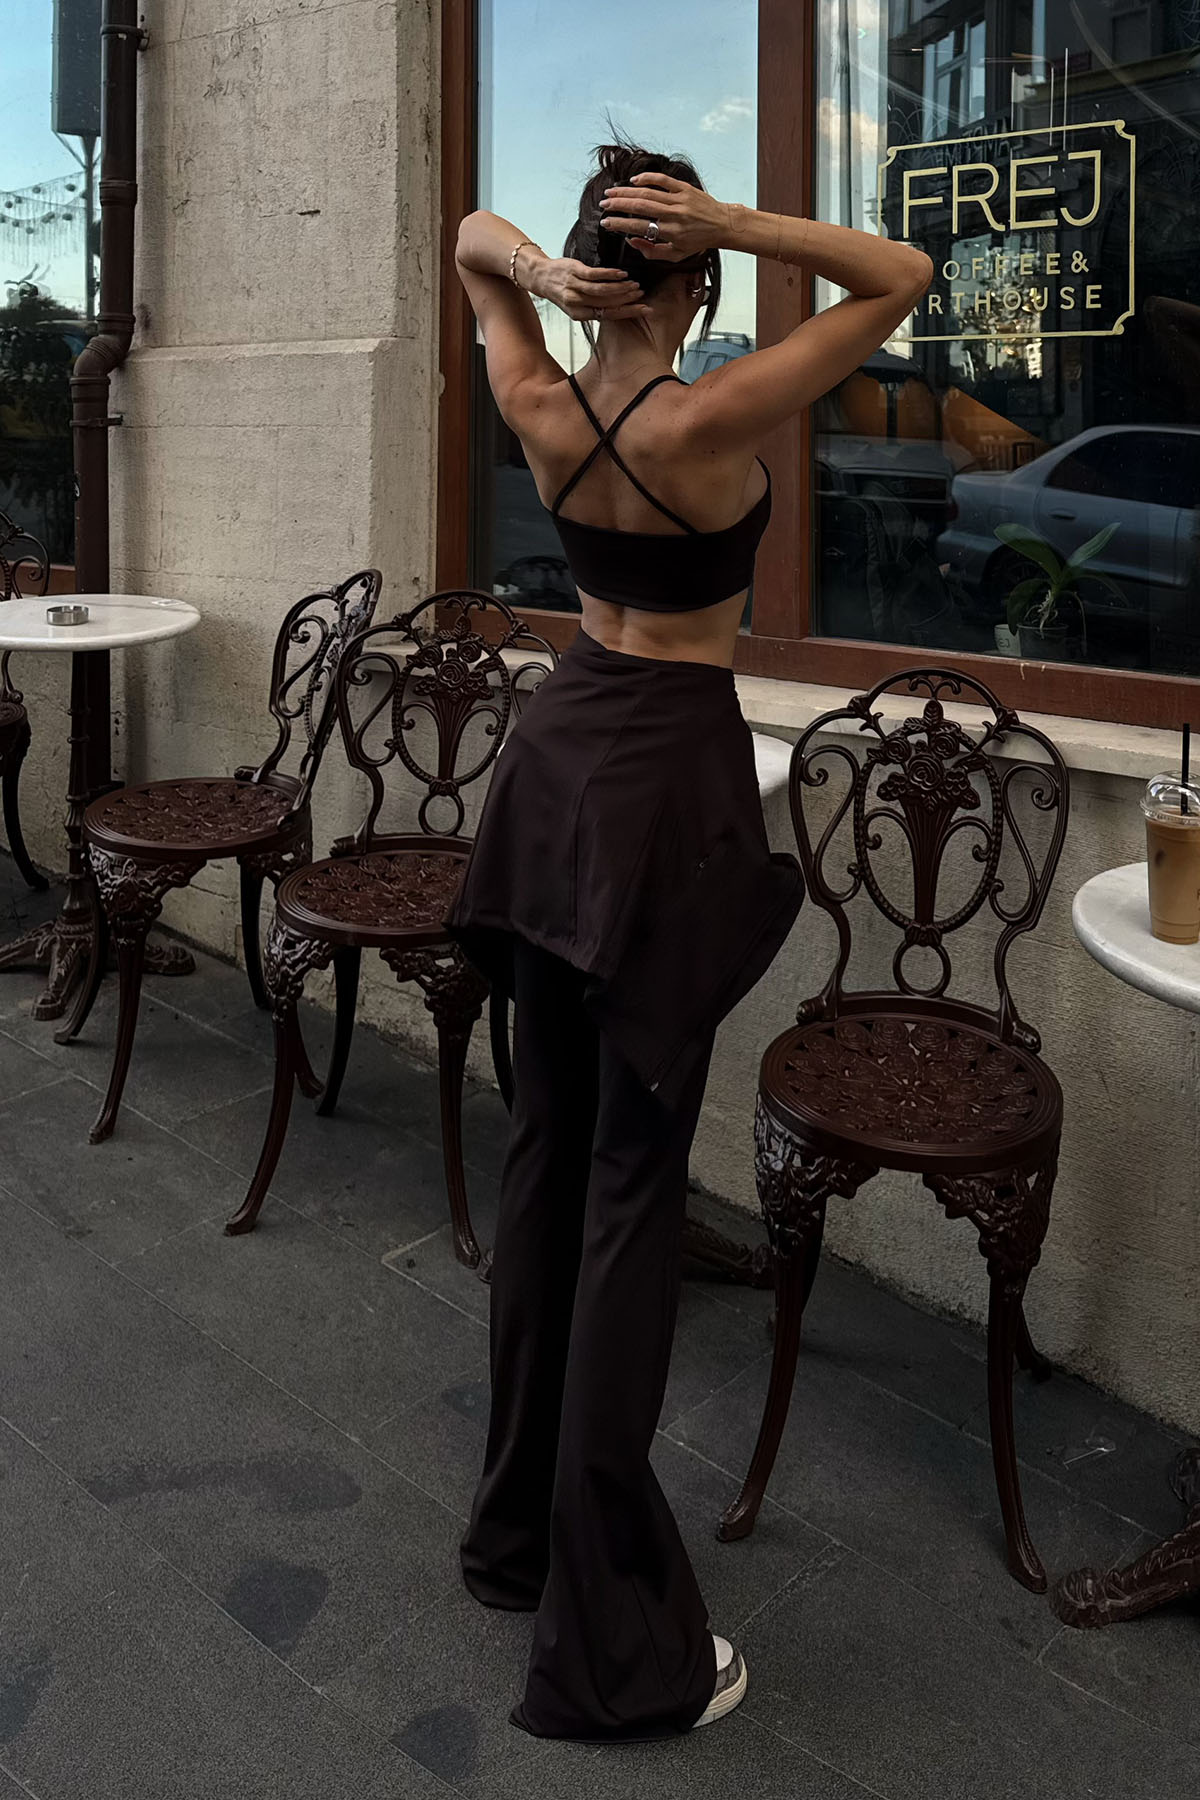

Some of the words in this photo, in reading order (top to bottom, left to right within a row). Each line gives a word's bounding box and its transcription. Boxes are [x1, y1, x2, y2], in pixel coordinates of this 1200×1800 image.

[903, 150, 1101, 238] FREJ
[942, 251, 1090, 281] OFFEE&
[911, 284, 1102, 316] RTHOUSE
